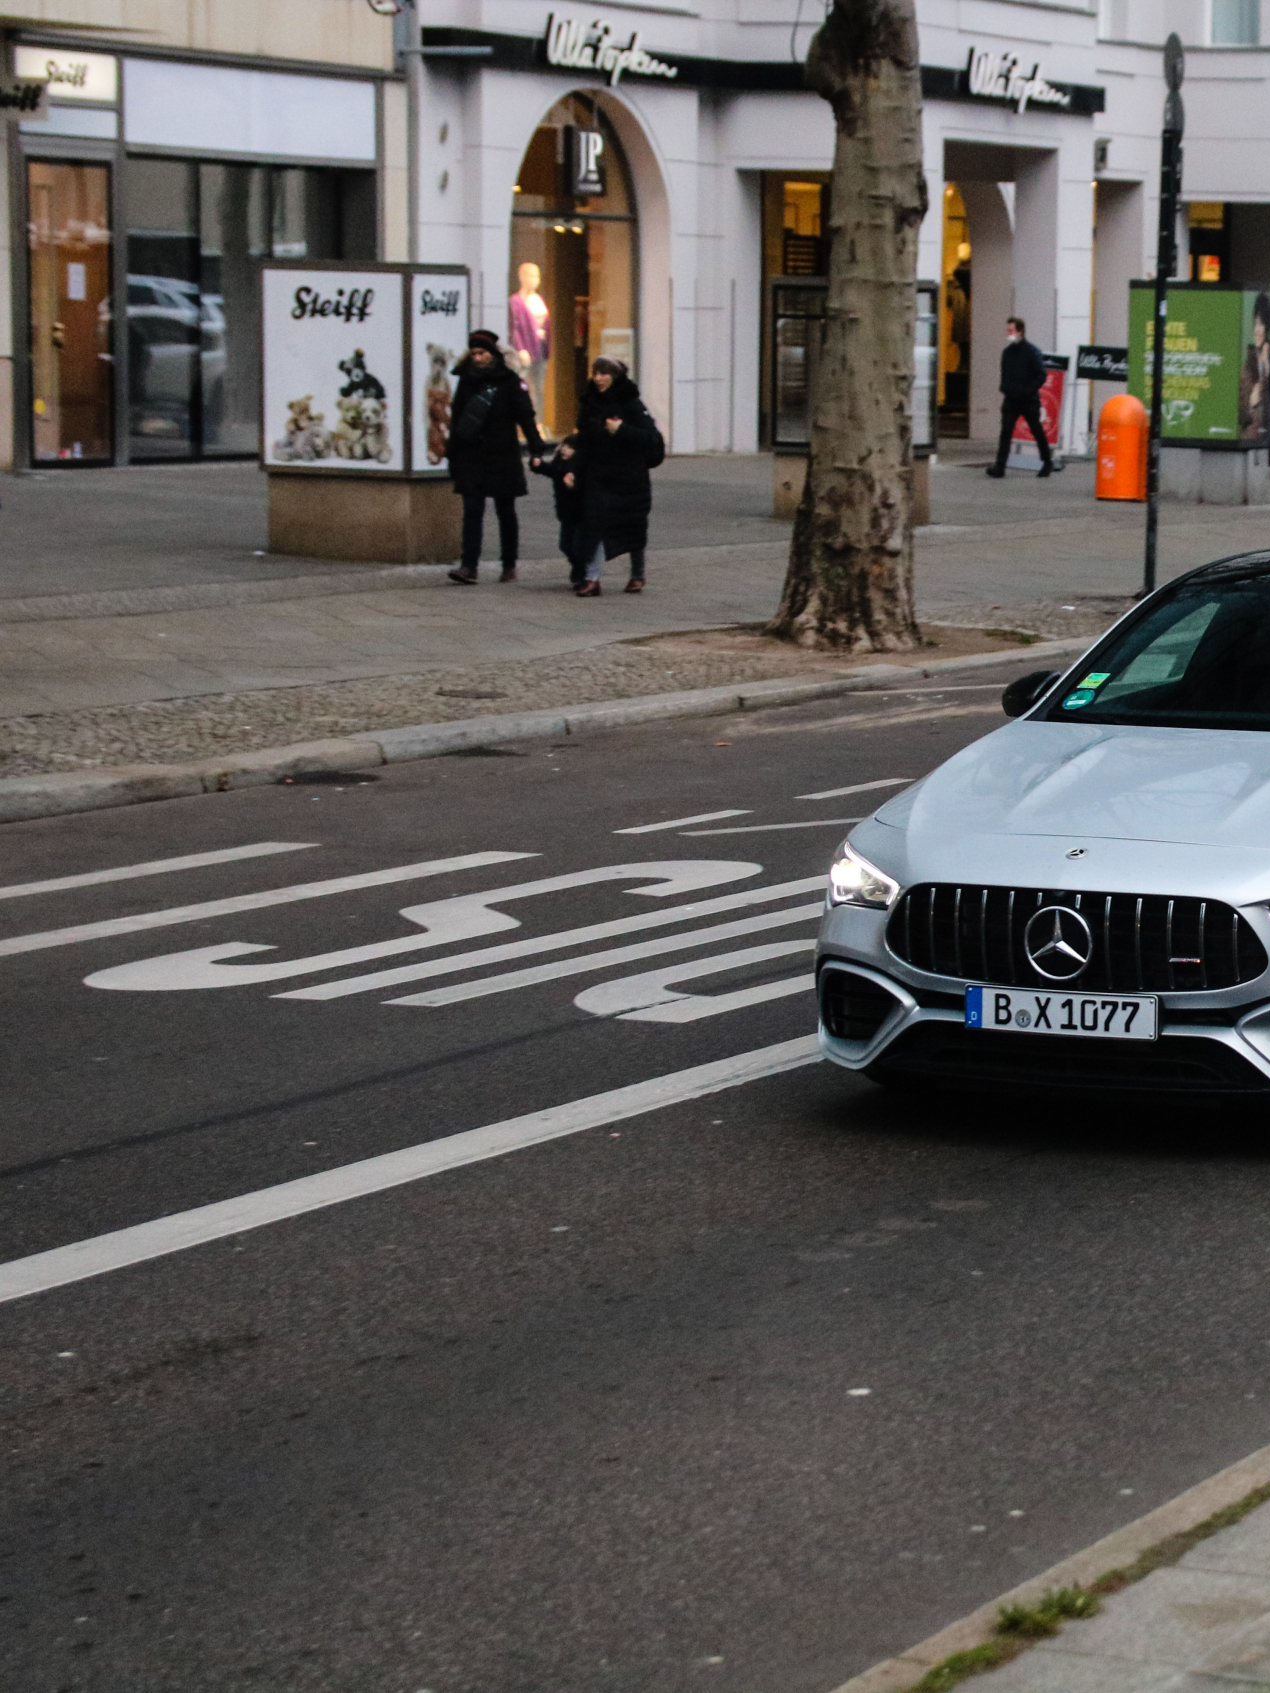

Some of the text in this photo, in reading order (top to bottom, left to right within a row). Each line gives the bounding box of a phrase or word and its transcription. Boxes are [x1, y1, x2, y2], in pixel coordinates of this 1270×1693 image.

[546, 12, 594, 69] Ulla
[291, 285, 375, 322] Steiff
[420, 289, 461, 316] Steiff
[994, 993, 1012, 1025] B
[1034, 996, 1052, 1029] X
[1060, 998, 1140, 1033] 1077
